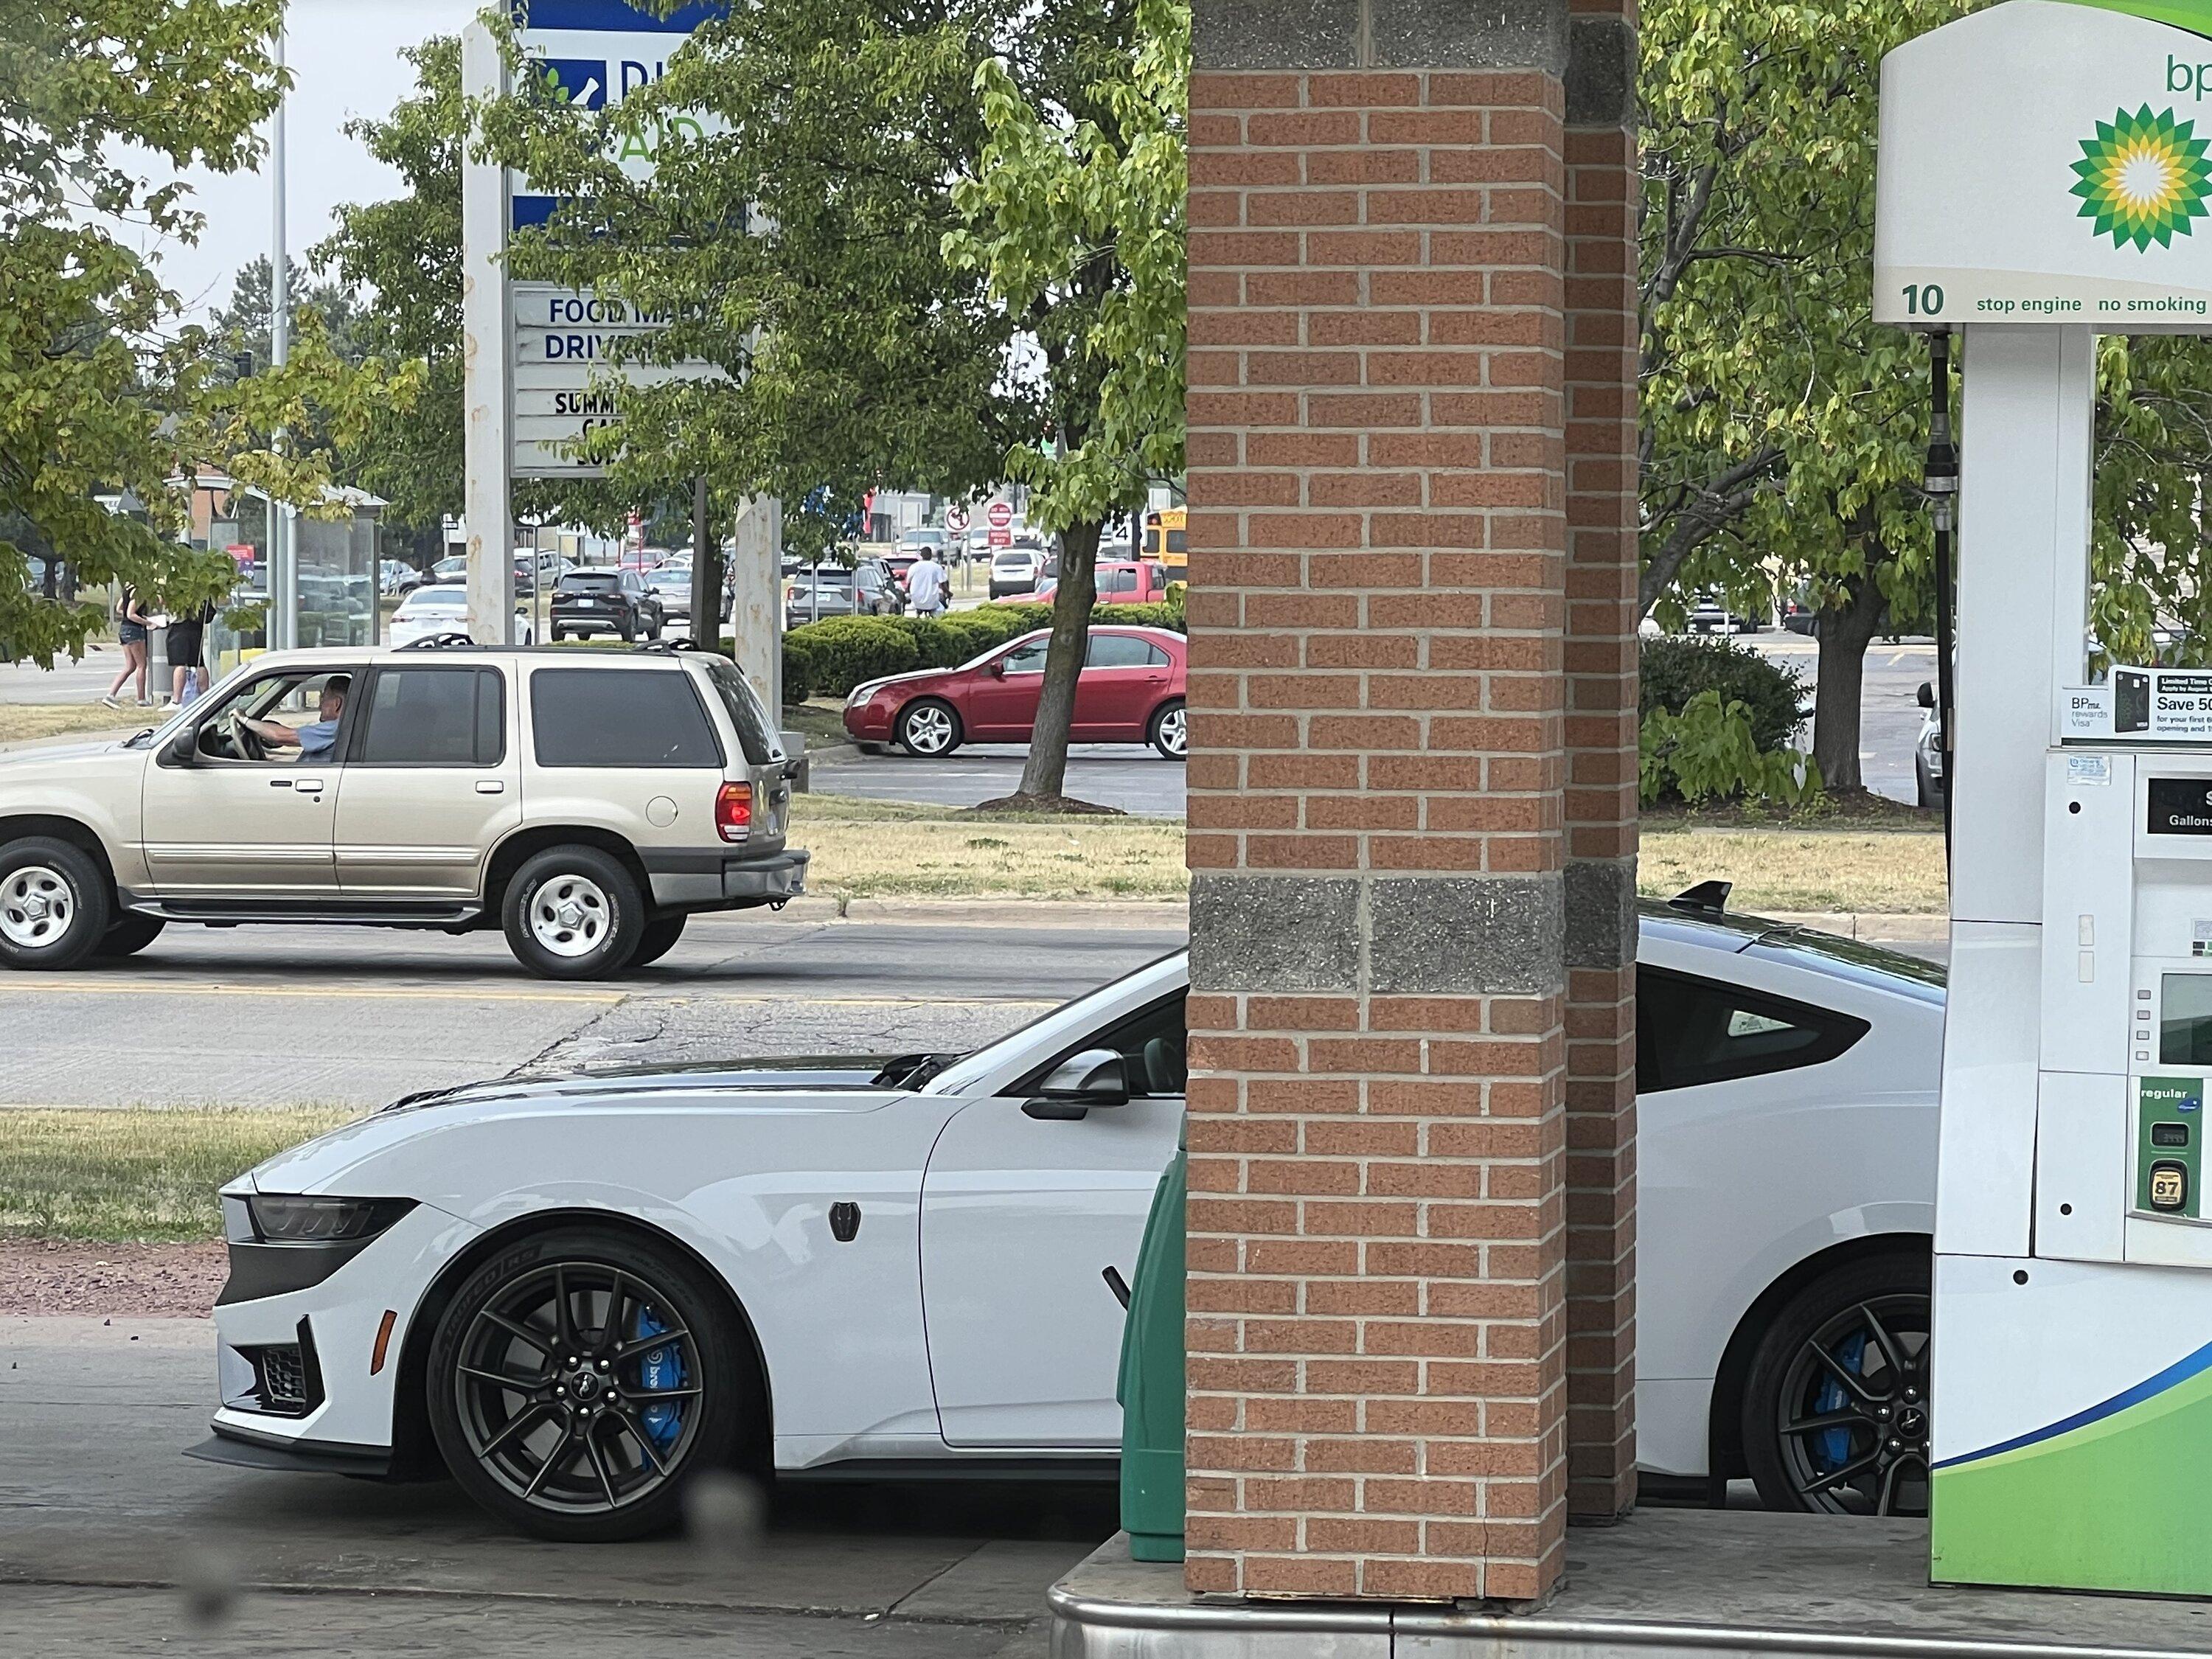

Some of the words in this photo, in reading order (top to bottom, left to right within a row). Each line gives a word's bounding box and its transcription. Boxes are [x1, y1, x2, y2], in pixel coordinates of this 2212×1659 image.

[2166, 54, 2212, 102] bp
[1902, 285, 1944, 315] 10
[1977, 298, 2014, 313] stop
[2021, 297, 2081, 314] engine
[2099, 299, 2120, 311] no
[2127, 297, 2207, 315] smoking
[2157, 697, 2194, 711] Save
[2072, 711, 2108, 719] rewards
[2141, 1088, 2188, 1099] regular
[2155, 1181, 2179, 1195] 87
